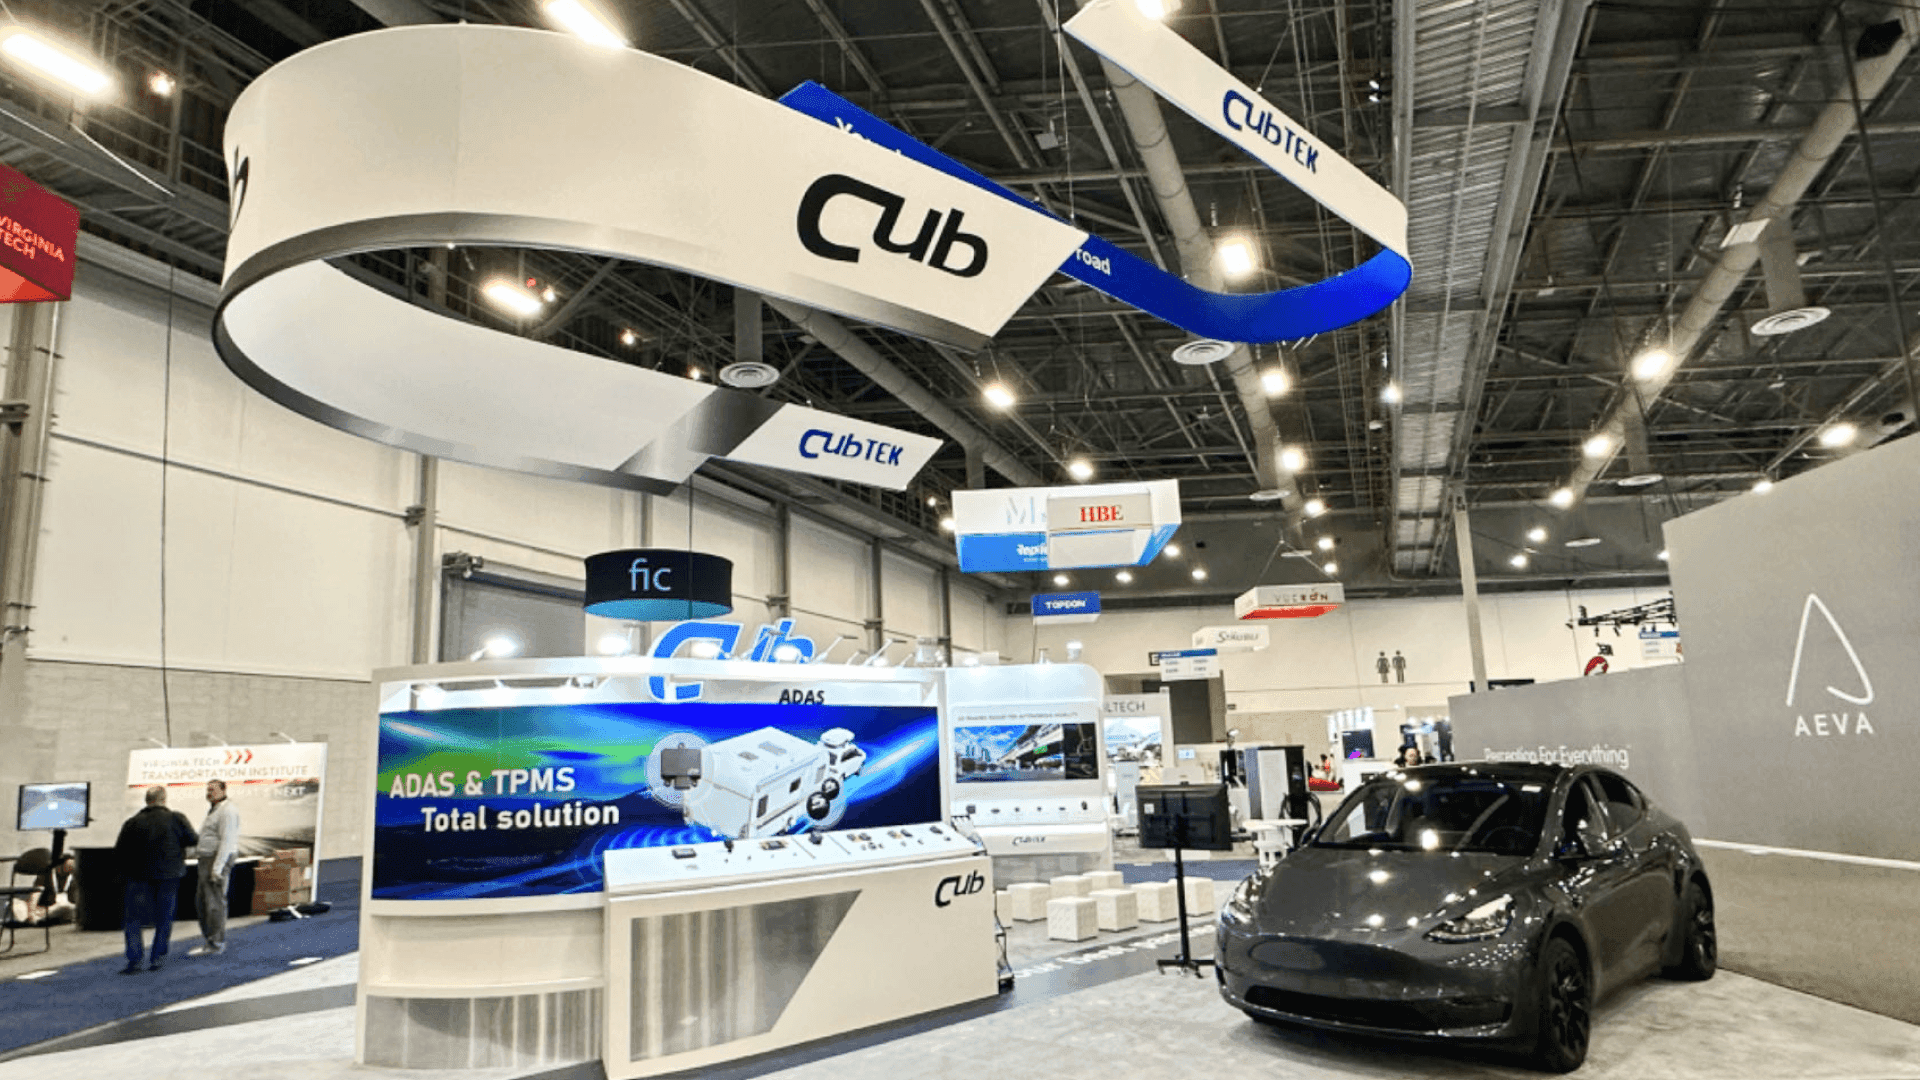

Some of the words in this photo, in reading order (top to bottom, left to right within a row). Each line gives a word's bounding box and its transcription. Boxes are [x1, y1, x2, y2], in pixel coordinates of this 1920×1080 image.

[797, 173, 988, 278] Cub
[1079, 504, 1125, 522] HBE
[629, 557, 672, 592] fic
[779, 688, 825, 706] ADAS
[1794, 712, 1875, 738] AEVA
[1559, 744, 1629, 770] Everything
[389, 771, 456, 798] ADAS
[463, 769, 485, 796] &
[491, 766, 576, 796] TPMS
[421, 804, 488, 833] Total
[496, 800, 620, 830] solution
[934, 869, 986, 908] Cub
